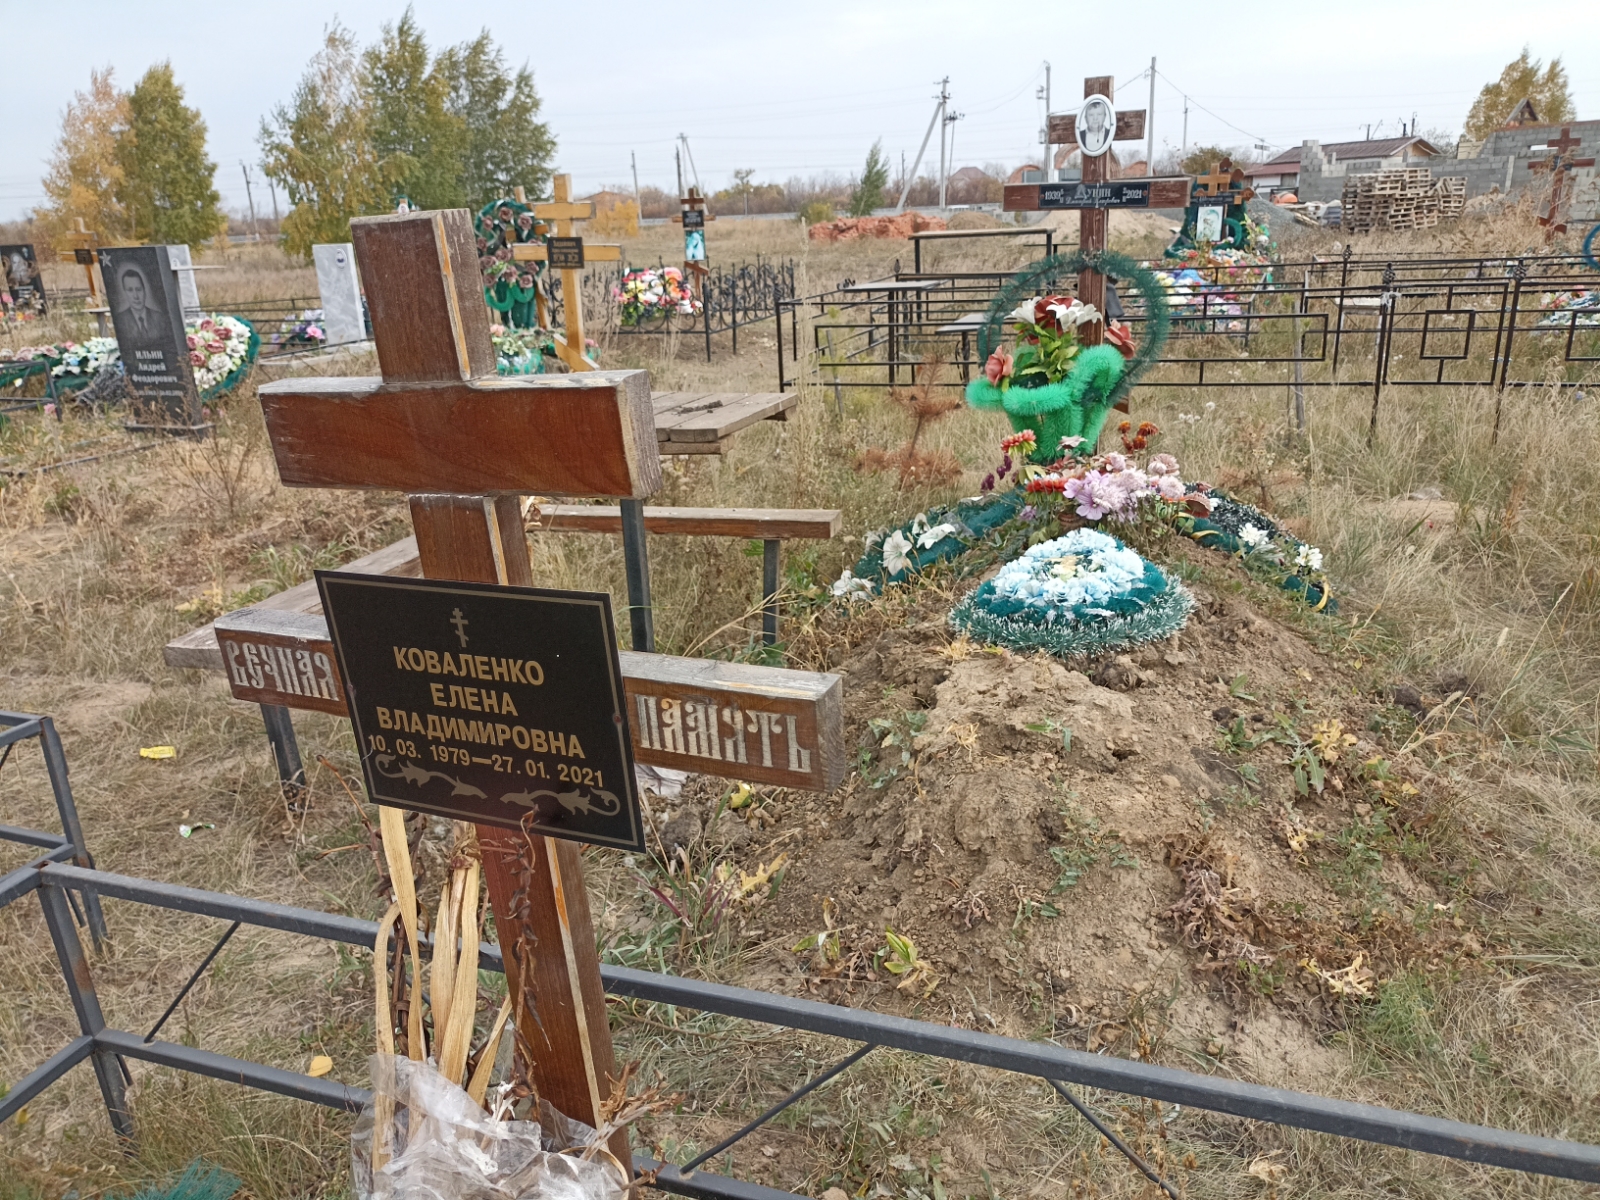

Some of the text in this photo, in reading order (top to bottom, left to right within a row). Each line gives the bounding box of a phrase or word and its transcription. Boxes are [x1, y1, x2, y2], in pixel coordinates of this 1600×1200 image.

[1126, 189, 1142, 199] 2021
[135, 350, 163, 359] ИЛЬИН
[138, 362, 166, 372] Андрей
[393, 646, 544, 686] КОВАЛЕНКО
[430, 683, 519, 717] ЕЛЕНА
[376, 706, 586, 759] ВЛАДИМИРОВНА
[558, 764, 604, 788] 2021
